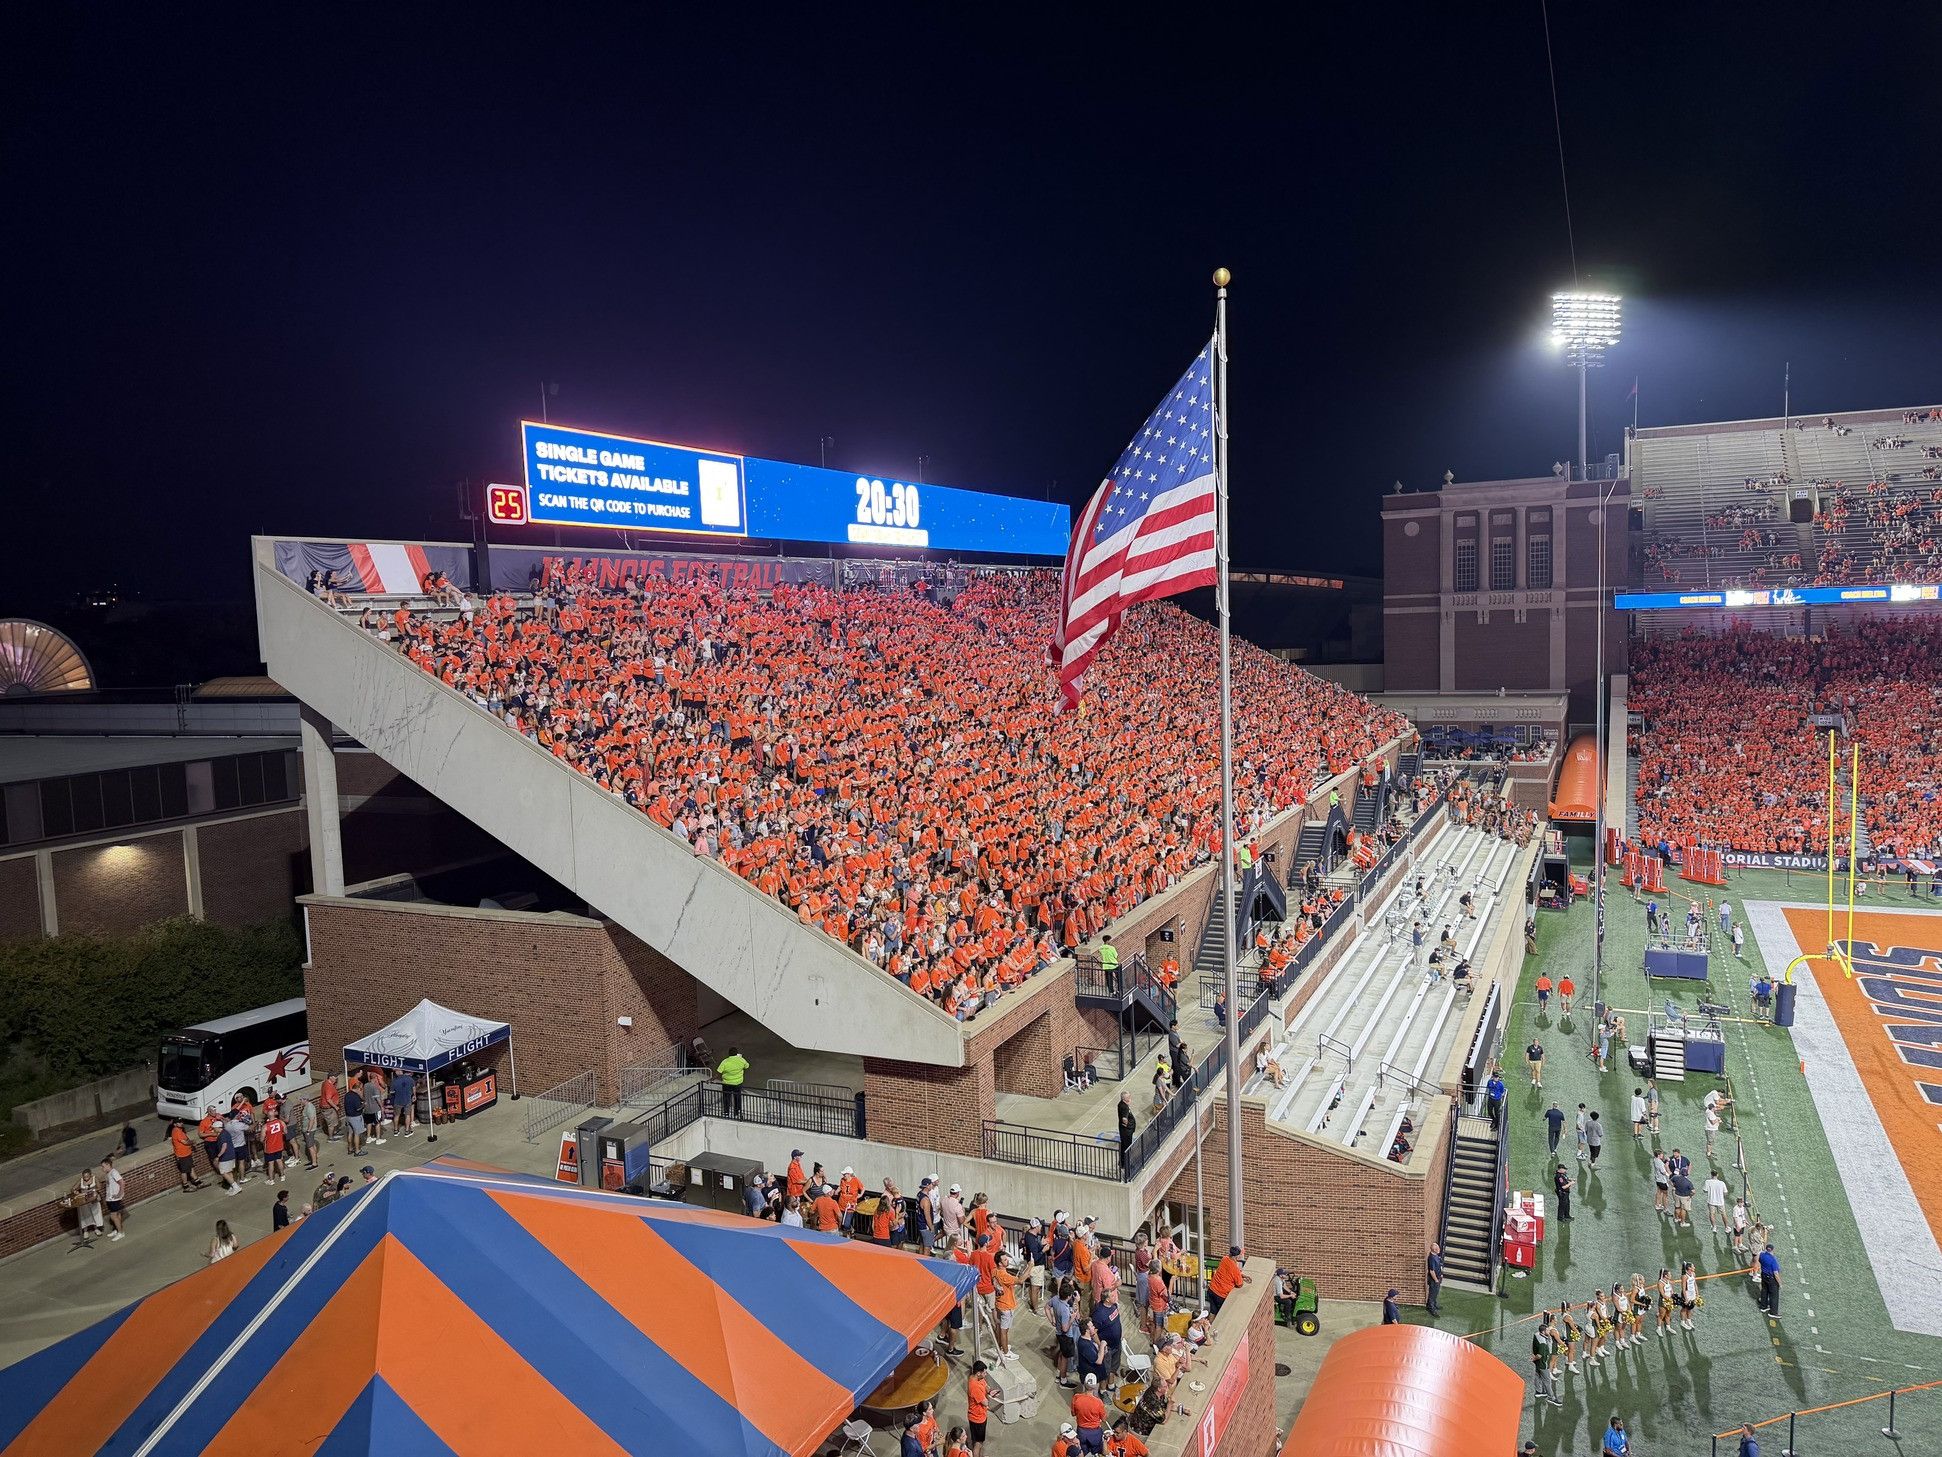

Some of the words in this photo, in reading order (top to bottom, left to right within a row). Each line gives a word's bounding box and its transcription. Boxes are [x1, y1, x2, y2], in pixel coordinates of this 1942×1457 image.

[535, 441, 598, 465] SINGLE
[599, 450, 645, 471] GAME
[536, 463, 608, 487] TICKETS
[610, 472, 690, 496] AVAILABLE
[493, 490, 521, 519] 25
[538, 493, 567, 508] SCAN
[568, 495, 589, 510] THE
[590, 498, 605, 512] QR
[606, 499, 632, 514] CODE
[632, 502, 646, 515] TO
[647, 503, 691, 519] PURCHASE
[856, 477, 920, 528] 20:30
[541, 556, 665, 588] IINOIS
[671, 559, 783, 590] FOTBALL
[1721, 853, 1769, 866] ORIAL
[363, 1052, 406, 1068] FLIGHT
[448, 1033, 491, 1061] FLIGHT
[270, 1122, 281, 1135] 23
